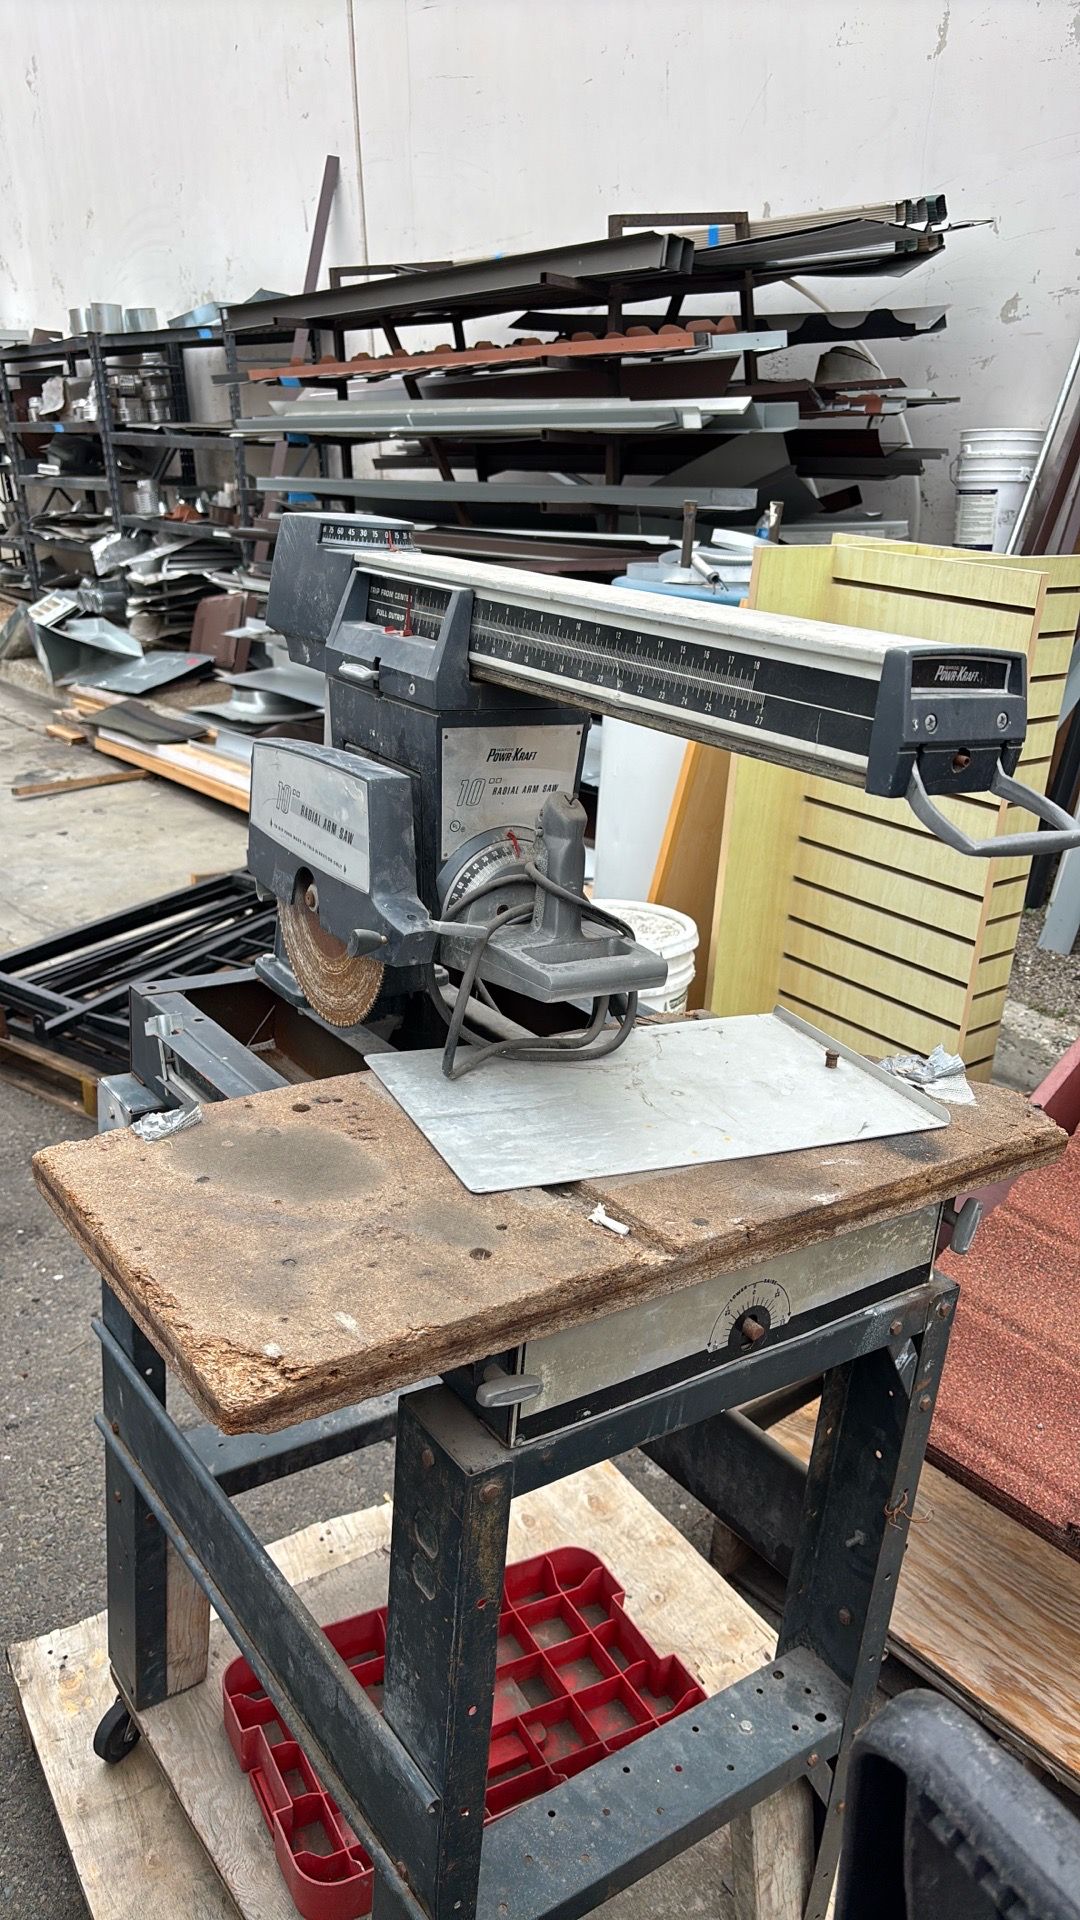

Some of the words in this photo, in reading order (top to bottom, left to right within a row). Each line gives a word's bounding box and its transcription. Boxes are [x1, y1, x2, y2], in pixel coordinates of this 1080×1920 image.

[380, 588, 394, 598] FROM
[376, 608, 388, 618] FULL
[658, 640, 664, 649] 14
[680, 646, 686, 654] 15
[704, 651, 710, 659] 16
[728, 656, 735, 664] 17
[754, 661, 760, 670] 18
[637, 685, 644, 693] 22
[658, 691, 665, 699] 23
[681, 696, 688, 706] 24
[705, 702, 712, 711] 25
[729, 709, 737, 718] 26
[755, 715, 763, 725] 27
[492, 786, 519, 795] RADIAL
[522, 784, 538, 794] ARM
[542, 784, 559, 792] SAW
[300, 805, 320, 827] RADIAL
[323, 818, 337, 836] ARM
[339, 827, 355, 845] SAW
